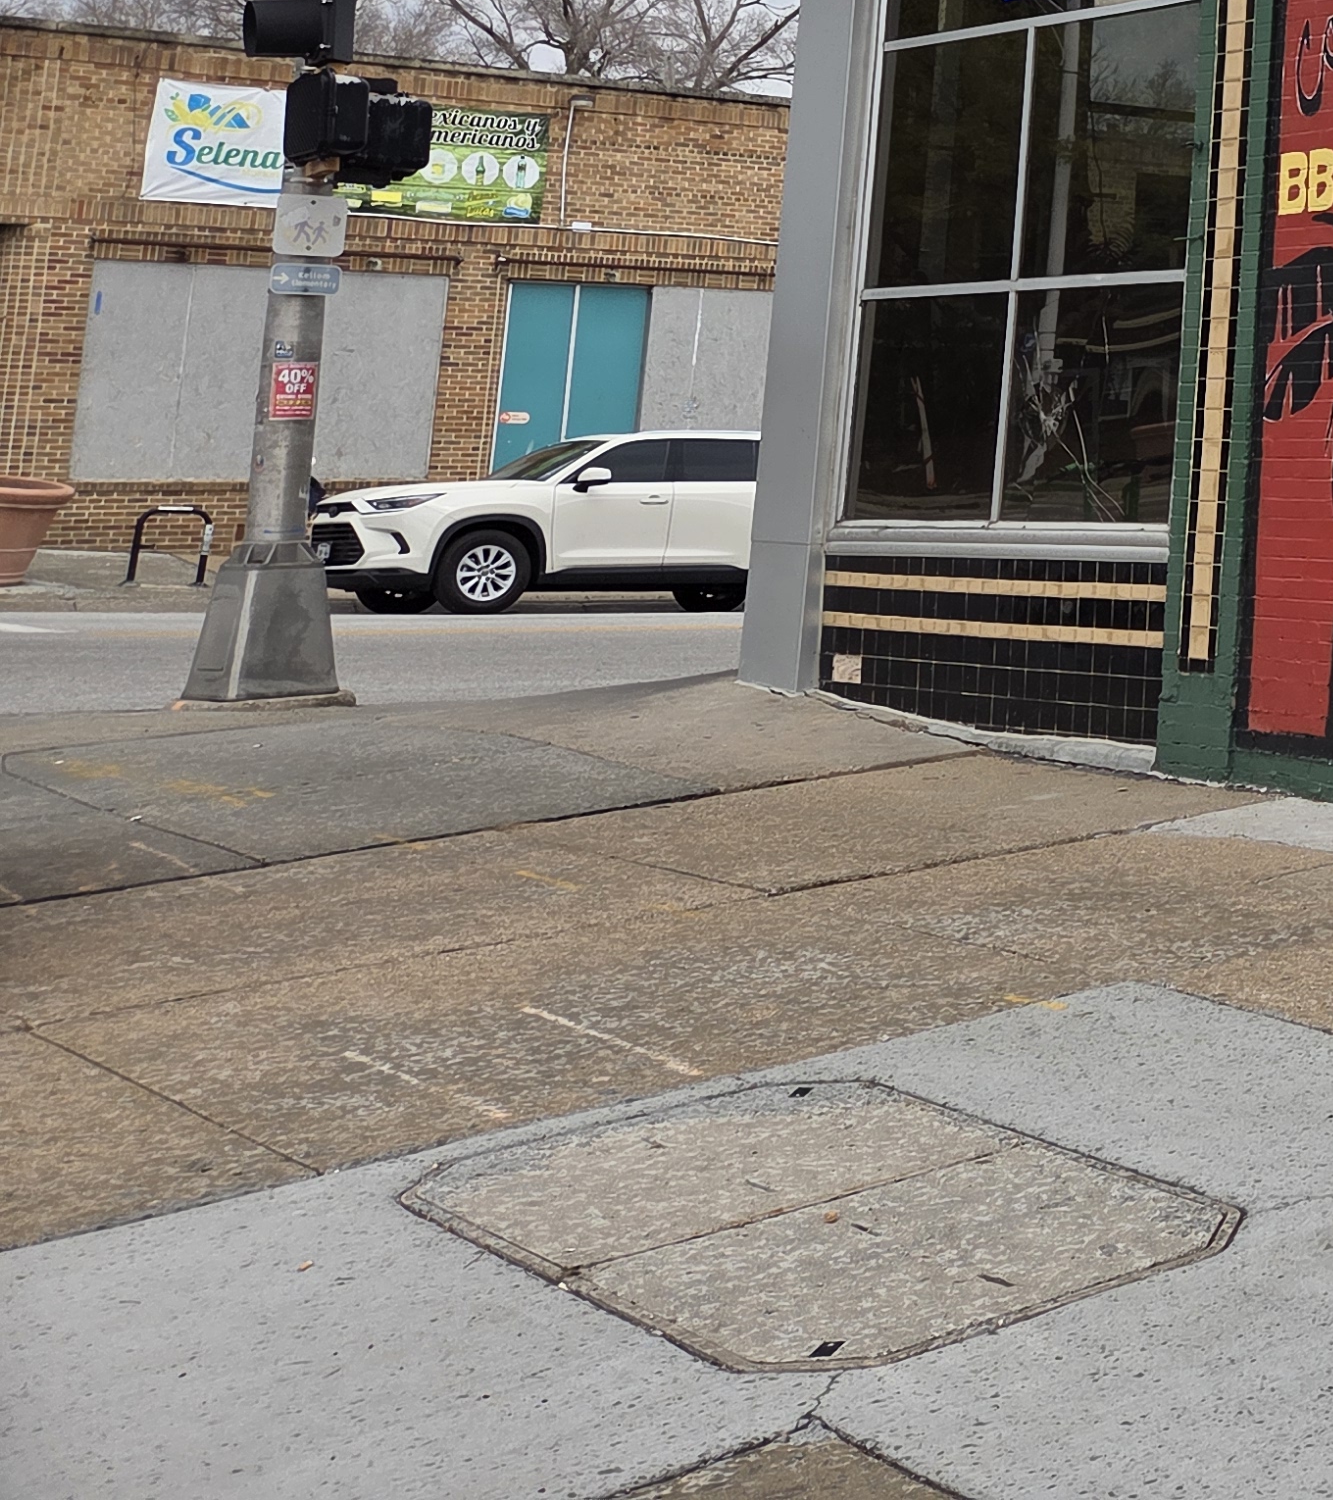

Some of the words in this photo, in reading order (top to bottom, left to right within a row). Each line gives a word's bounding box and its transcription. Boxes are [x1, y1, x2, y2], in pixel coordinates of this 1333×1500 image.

[431, 109, 520, 132] exicanos
[525, 118, 540, 137] y
[165, 126, 285, 171] Selena
[431, 128, 538, 150] mericanos
[278, 369, 315, 384] 40%
[285, 383, 308, 394] OFF
